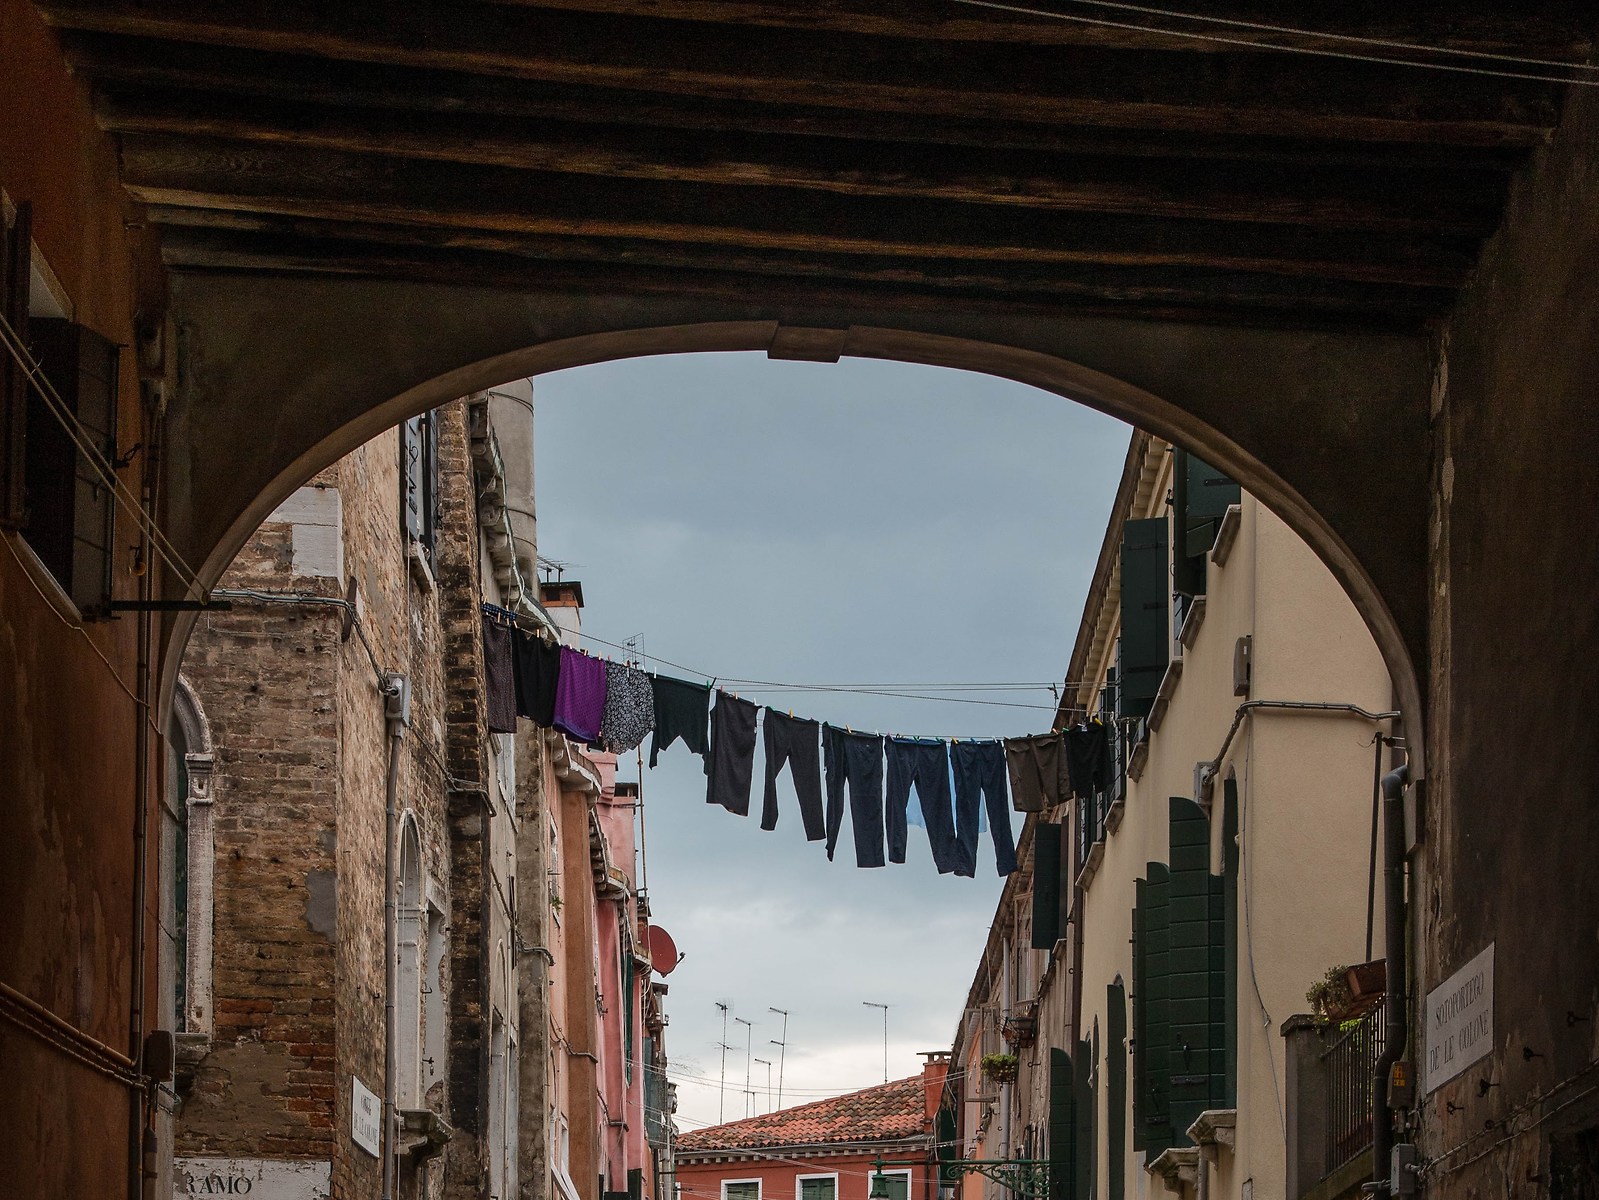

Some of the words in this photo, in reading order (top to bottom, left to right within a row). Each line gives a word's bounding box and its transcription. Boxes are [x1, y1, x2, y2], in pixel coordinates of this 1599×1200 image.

[1435, 972, 1484, 1030] SOTOPORTEGO
[1430, 1045, 1439, 1074] DE
[1444, 1035, 1454, 1064] LE
[1459, 1010, 1489, 1051] COLONE
